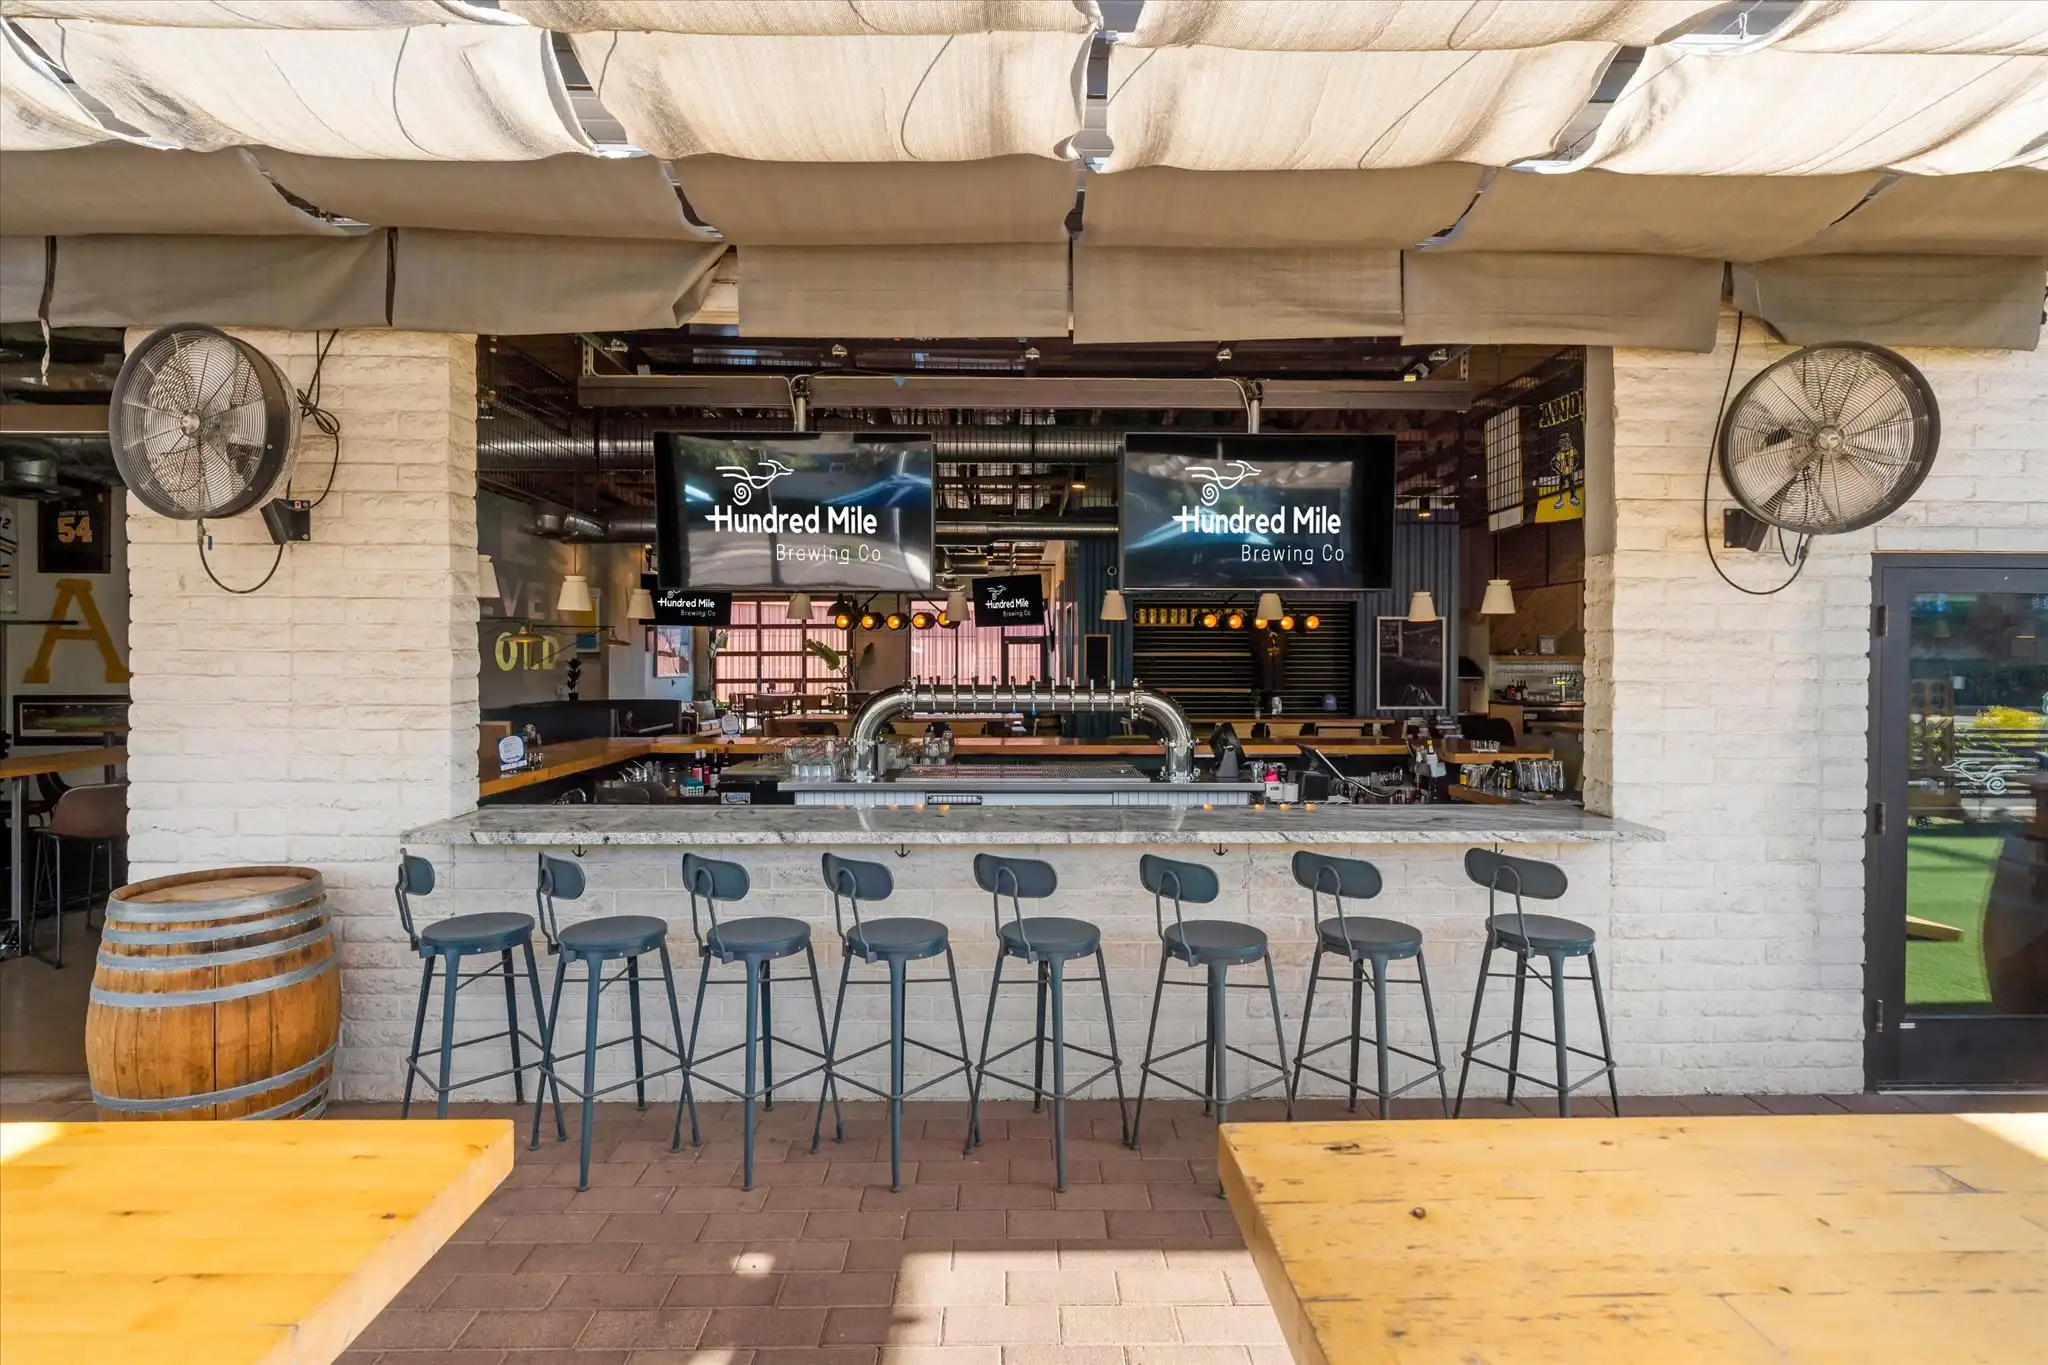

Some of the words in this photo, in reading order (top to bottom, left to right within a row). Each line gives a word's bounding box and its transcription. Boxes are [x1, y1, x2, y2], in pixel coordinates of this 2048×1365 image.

[57, 516, 92, 543] 54
[705, 505, 819, 534] Hundred
[828, 506, 878, 534] Mile
[1172, 505, 1286, 534] Hundred
[1293, 505, 1342, 534] Mile
[776, 544, 850, 565] Brewing
[858, 544, 881, 562] Co
[1241, 544, 1314, 565] Brewing
[1322, 544, 1345, 562] Co
[657, 598, 697, 608] Hundred
[698, 598, 716, 608] Mile
[985, 599, 1015, 609] Hundred
[1015, 597, 1030, 608] Mile
[22, 579, 130, 684] A
